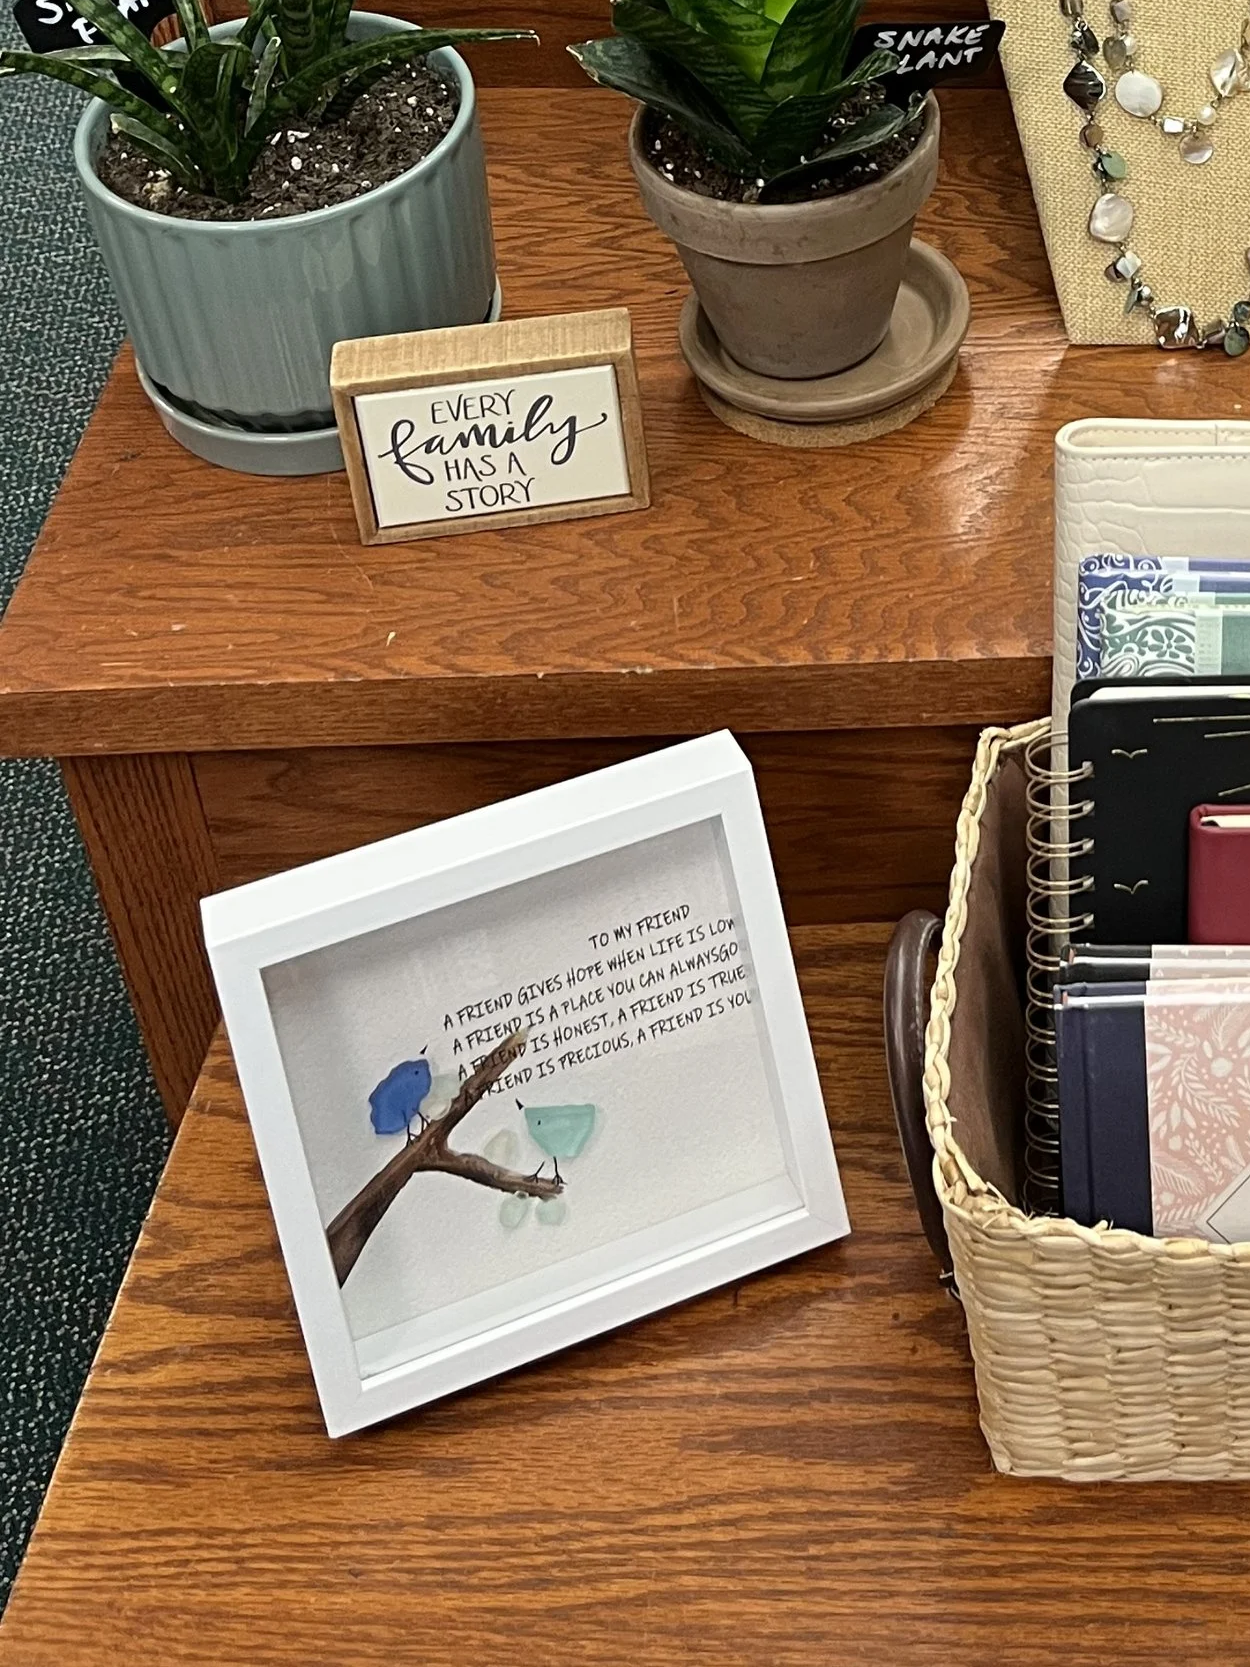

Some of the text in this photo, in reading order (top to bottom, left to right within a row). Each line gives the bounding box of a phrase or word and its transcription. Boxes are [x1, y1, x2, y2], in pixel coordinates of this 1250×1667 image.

[873, 24, 991, 52] SNAKE
[895, 46, 984, 75] LANT
[430, 388, 516, 425] EVERY
[376, 394, 608, 485] family
[444, 451, 528, 483] HAS A
[444, 477, 536, 513] STORY
[588, 904, 691, 950] TO MY FRIEND
[443, 1013, 454, 1031] A
[455, 992, 513, 1027] FRIEND
[517, 973, 563, 1007] GIVES
[565, 961, 605, 990] HOPE
[606, 946, 646, 972] WHEN
[649, 932, 685, 957] LIFE
[686, 924, 706, 946] IS
[452, 1038, 463, 1056] A
[465, 1016, 522, 1051] FRIEND
[525, 1007, 546, 1029] IS
[548, 1004, 559, 1022] A
[560, 987, 606, 1016] PLACE
[606, 977, 636, 999] YOU
[638, 967, 666, 989] CAN
[457, 1063, 468, 1082] A
[529, 1033, 550, 1054] IS
[552, 1011, 615, 1048] HONEST,
[617, 1007, 628, 1026] A
[629, 986, 684, 1020] FRIEND
[686, 978, 706, 999] IS
[535, 1057, 556, 1079] IS
[557, 1030, 635, 1072] PRECIOUS,
[637, 1026, 648, 1043] A
[648, 1006, 704, 1034] FRIEND
[705, 997, 726, 1019] IS
